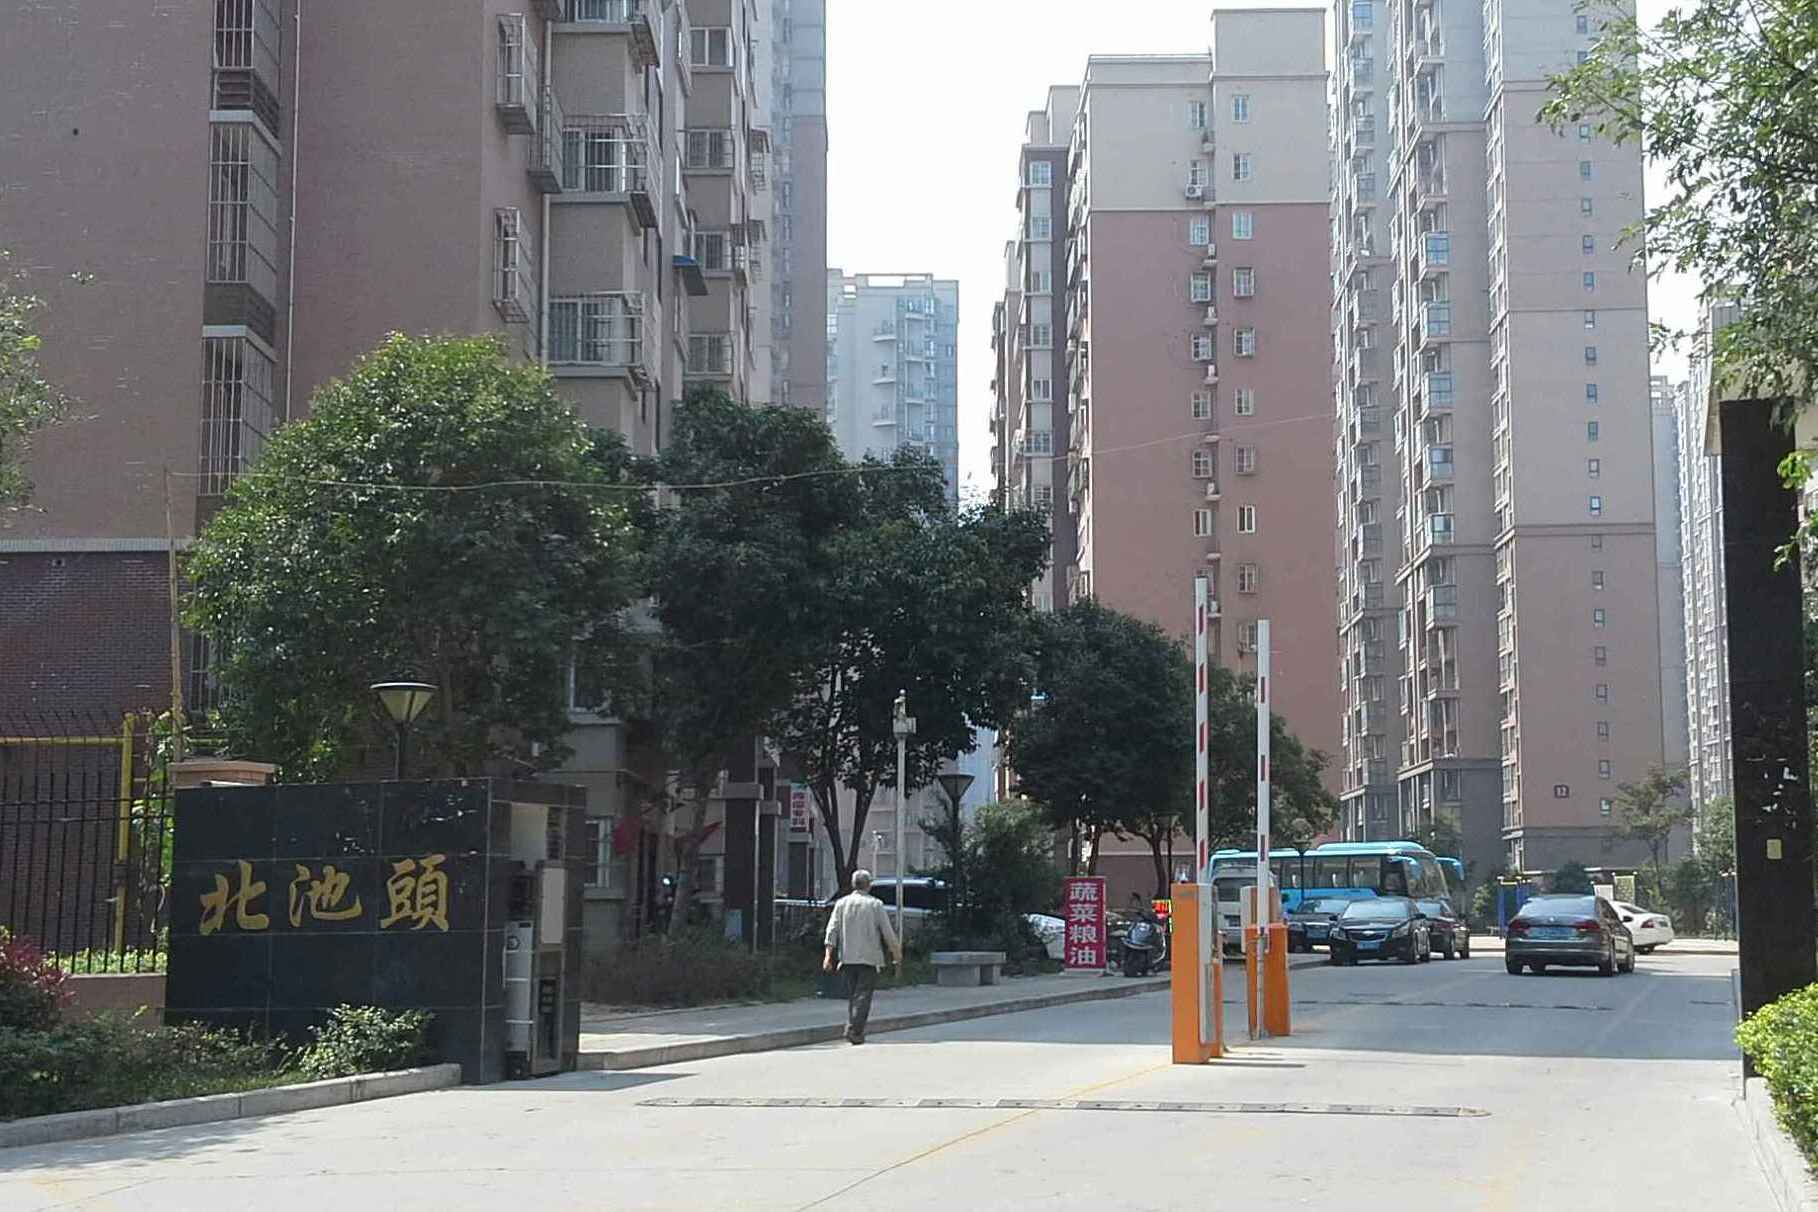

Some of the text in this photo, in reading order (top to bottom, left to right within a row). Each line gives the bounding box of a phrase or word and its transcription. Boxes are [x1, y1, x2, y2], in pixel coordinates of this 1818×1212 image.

[199, 853, 449, 936] 北池頭
[1069, 882, 1098, 965] 蔬菜粮油
